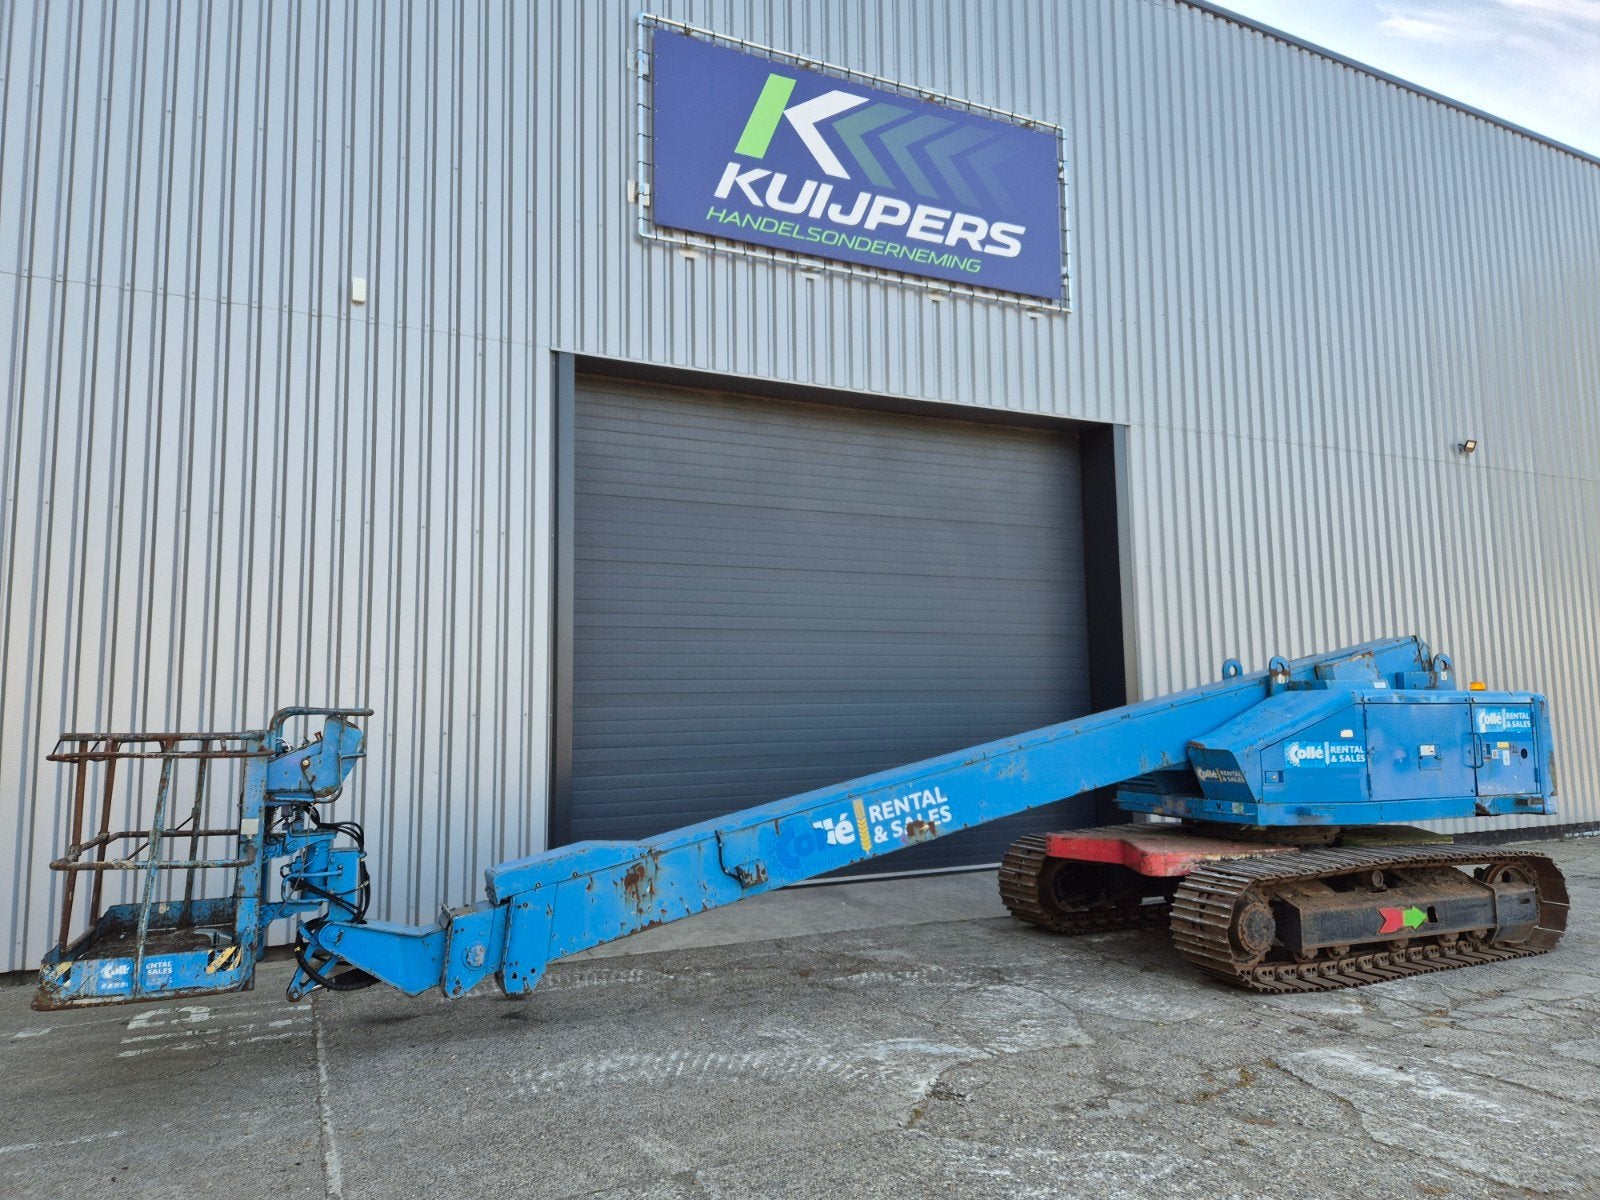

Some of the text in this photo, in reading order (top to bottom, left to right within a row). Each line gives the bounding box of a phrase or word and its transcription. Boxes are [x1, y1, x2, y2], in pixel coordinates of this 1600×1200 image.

[714, 162, 1026, 258] KUIJPERS
[706, 206, 981, 273] HANDELSONDERNEMING
[1505, 712, 1530, 720] RENTAL
[1512, 720, 1531, 728] SALES
[1330, 745, 1365, 754] RENTAL
[1330, 754, 1366, 763] & SALES
[868, 786, 948, 824] RENTAL
[874, 825, 889, 843] &
